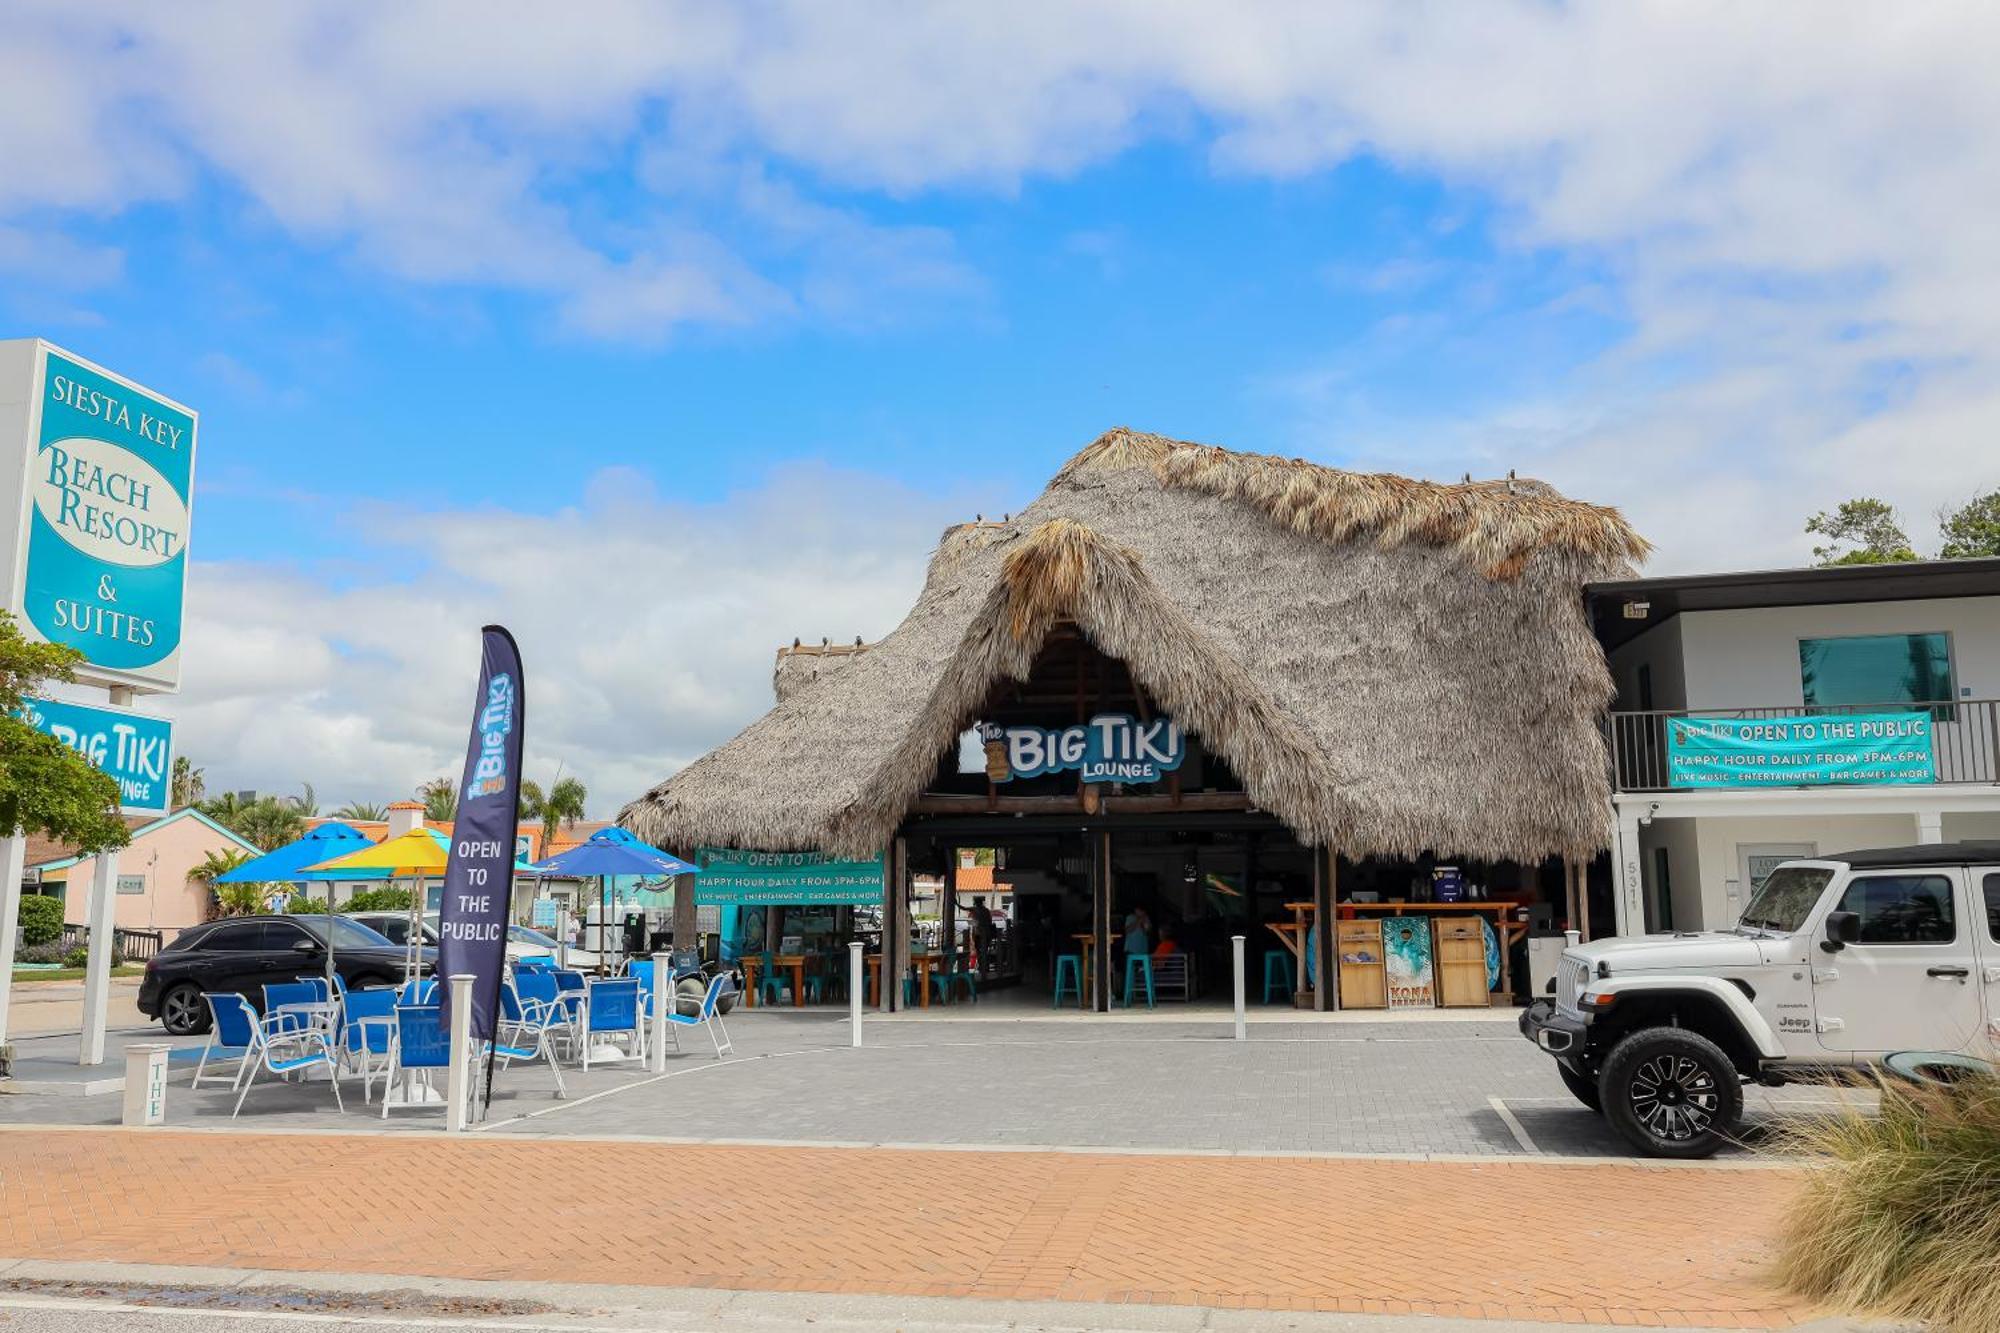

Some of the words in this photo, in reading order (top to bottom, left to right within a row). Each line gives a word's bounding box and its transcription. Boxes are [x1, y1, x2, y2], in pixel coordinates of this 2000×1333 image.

[52, 375, 131, 432] SIESTA
[139, 412, 183, 451] KEY
[45, 446, 152, 512] BEACH
[56, 485, 178, 558] RESORT
[98, 574, 117, 602] &
[54, 599, 155, 647] SUITES
[482, 676, 509, 730] TIKI
[1740, 724, 1788, 741] OPEN
[1793, 723, 1816, 739] TO
[1821, 722, 1856, 738] THE
[1861, 720, 1925, 737] PUBLIC
[51, 724, 108, 767] BIG
[112, 723, 167, 781] TIKI
[478, 731, 502, 779] BIG
[977, 722, 1002, 742] The
[1006, 728, 1087, 772] BIG
[1091, 717, 1179, 763] TIKI
[1674, 755, 1719, 766] HAPPY
[1724, 755, 1766, 765] HOUR
[1771, 753, 1812, 765] DAILY
[1817, 753, 1858, 763] FROM
[1863, 751, 1927, 762] 3PM-6PM
[1083, 762, 1154, 779] LOUNGE
[1675, 773, 1695, 782] LIVE
[1699, 773, 1729, 782] MUSIC
[1739, 771, 1820, 781] ENTERTAINMENT
[1830, 771, 1850, 779] BAR
[1853, 770, 1886, 779] GAMES
[1899, 769, 1929, 778] MORE
[458, 841, 502, 858] OPEN
[748, 853, 784, 866] OPEN
[787, 853, 804, 866] TO
[808, 852, 831, 865] THE
[467, 868, 488, 886] TO
[699, 877, 731, 887] HAPPY
[735, 877, 765, 887] HOUR
[768, 877, 797, 887] DAILY
[800, 877, 832, 886] FROM
[835, 876, 880, 885] 3PM-6PM
[458, 895, 490, 913] THE
[441, 921, 500, 941] PUBLIC
[1779, 1016, 1811, 1028] Jeep
[151, 1064, 163, 1117] THE
